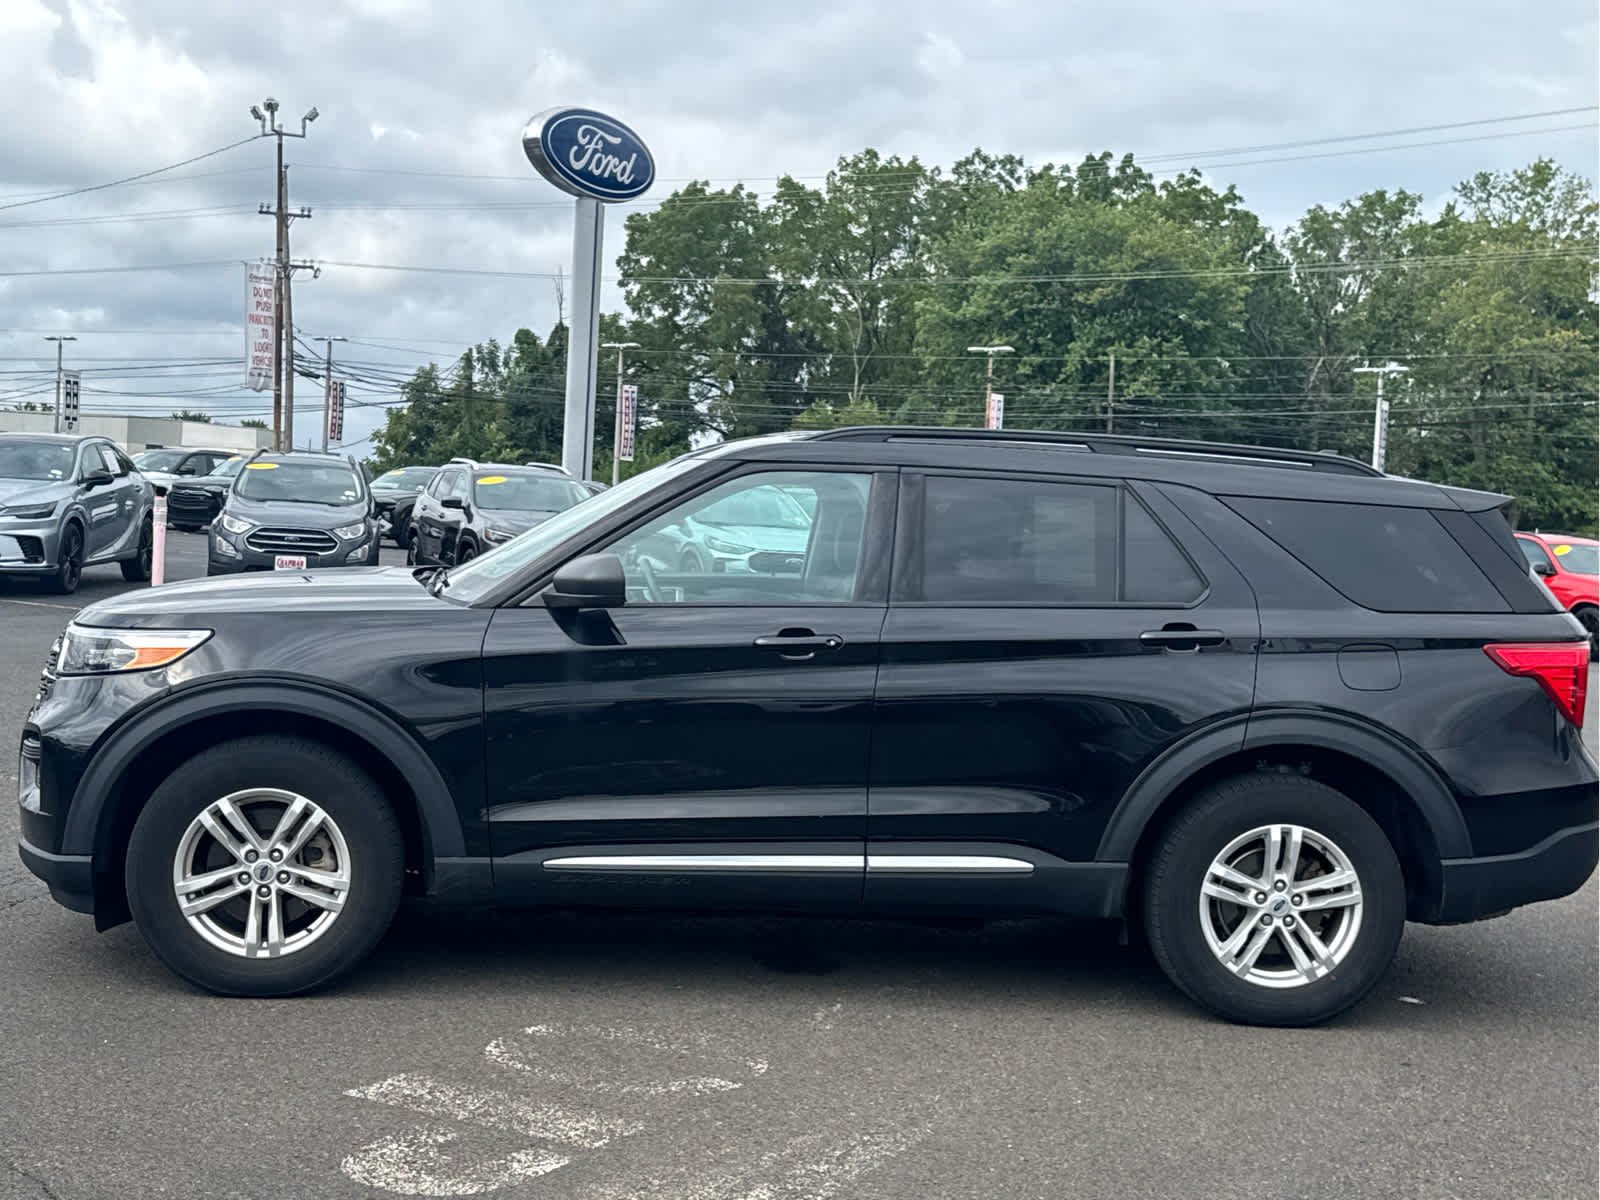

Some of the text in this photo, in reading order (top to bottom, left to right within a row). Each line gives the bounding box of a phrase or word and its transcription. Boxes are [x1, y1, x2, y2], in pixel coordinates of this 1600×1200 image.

[569, 124, 637, 185] Ford
[253, 286, 263, 298] DO
[261, 328, 268, 339] TO
